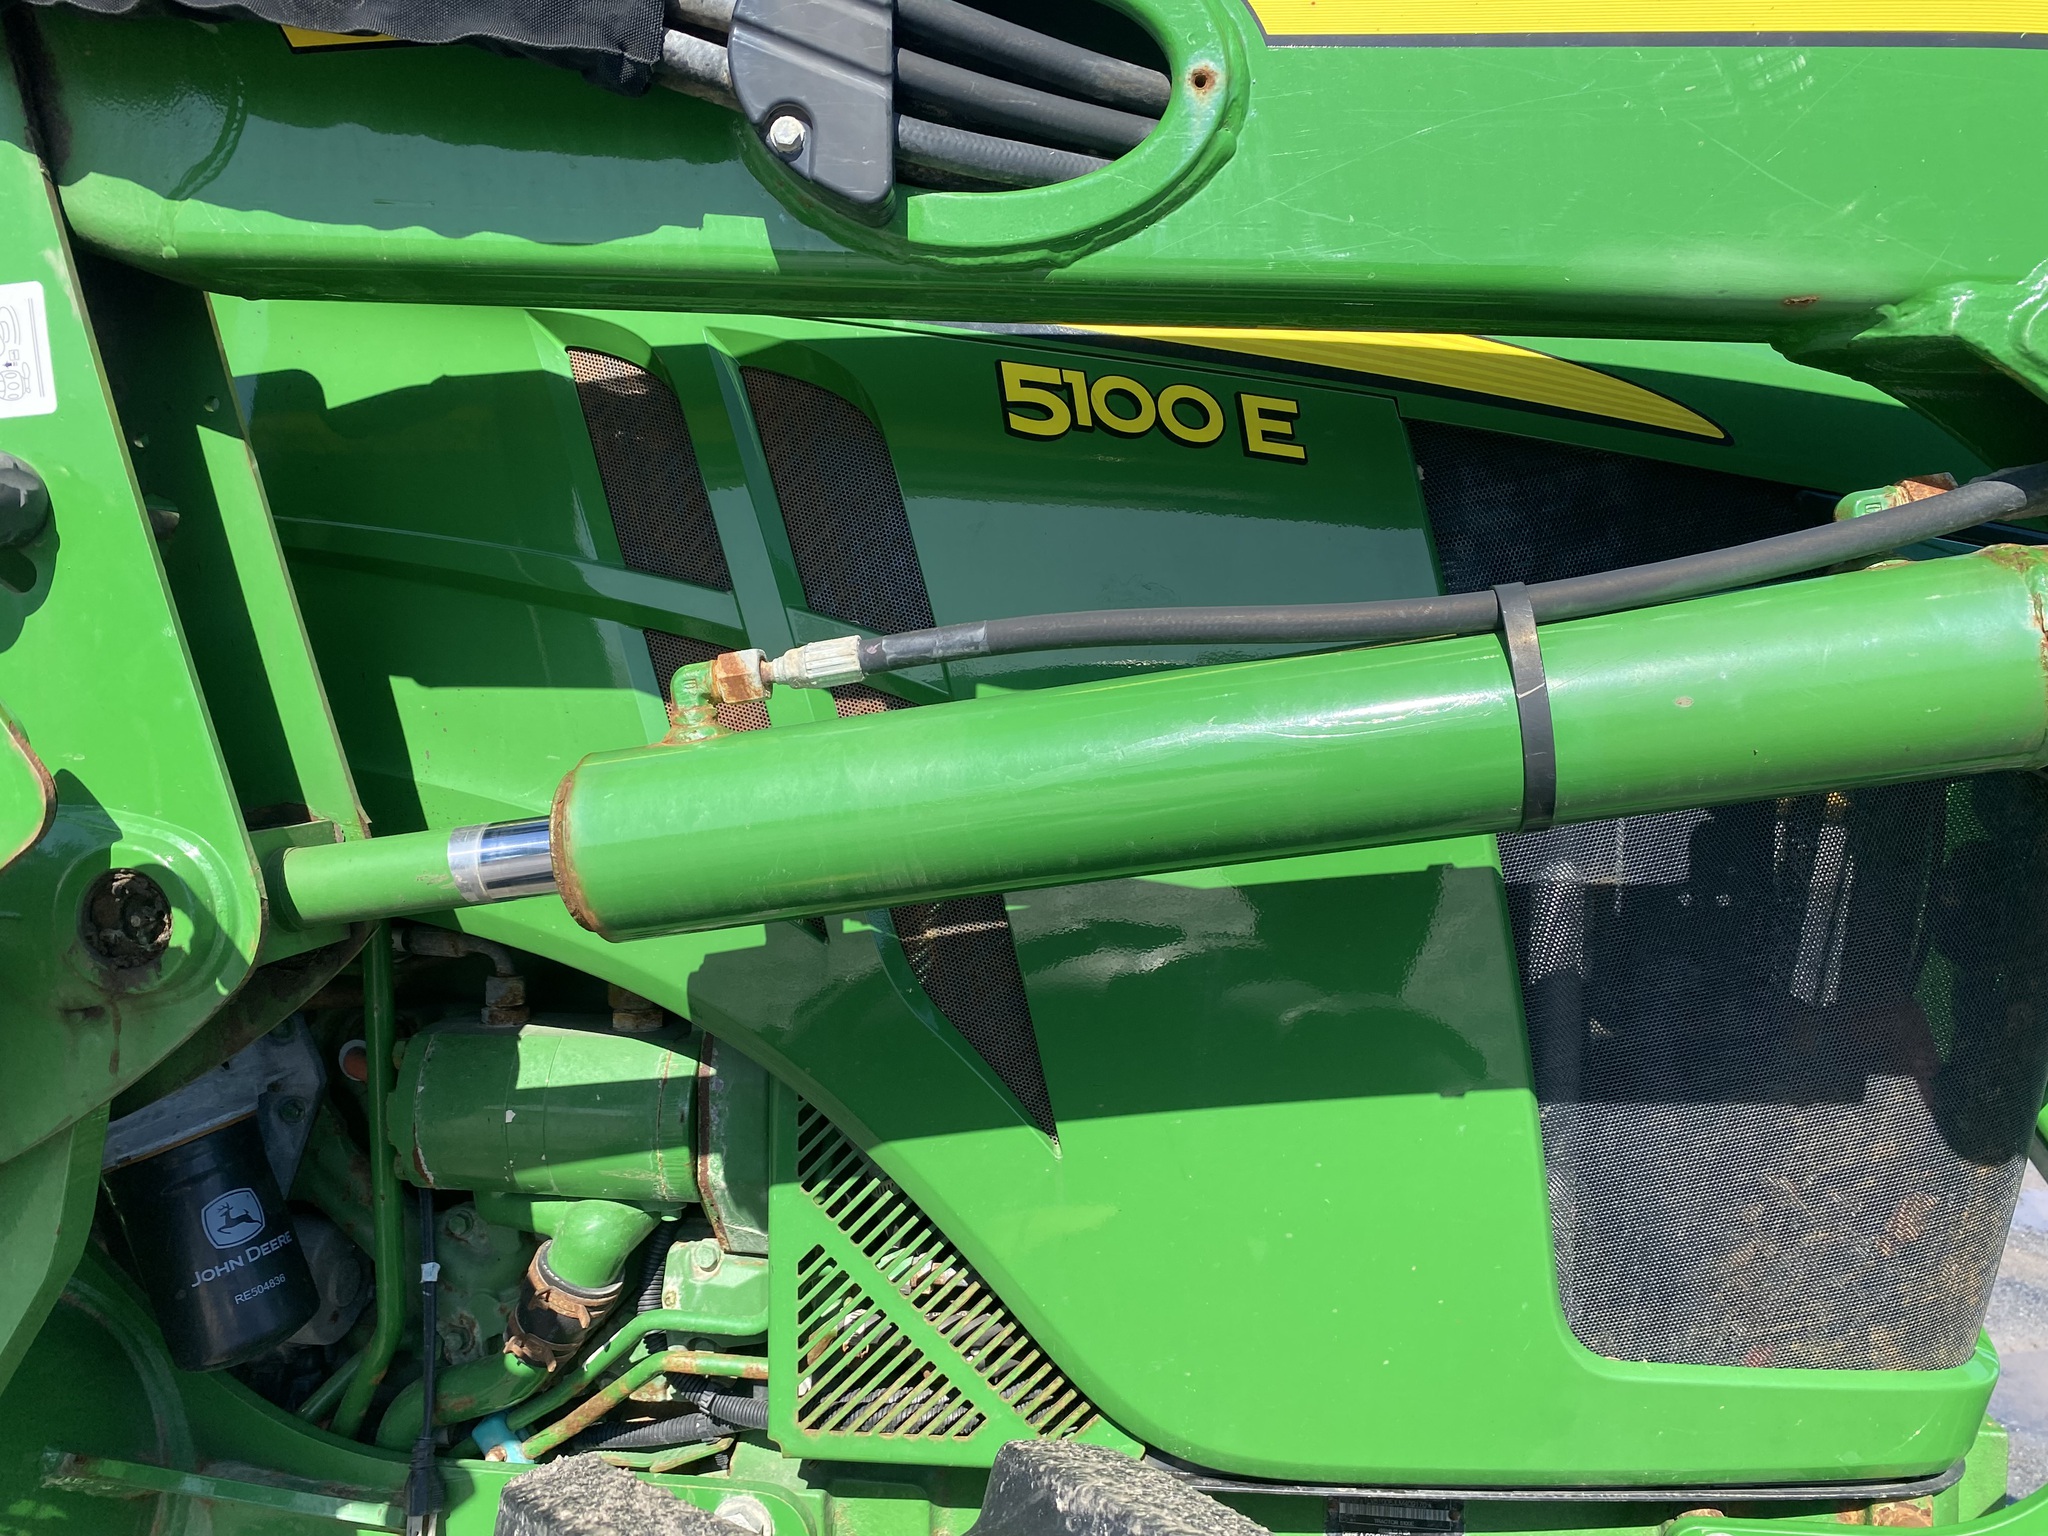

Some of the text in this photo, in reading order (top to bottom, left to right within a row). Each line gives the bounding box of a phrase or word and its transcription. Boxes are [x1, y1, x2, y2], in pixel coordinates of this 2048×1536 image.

[996, 360, 1307, 464] 5100 E
[192, 1231, 292, 1287] JOHN DEERE
[234, 1274, 286, 1304] RE504836
